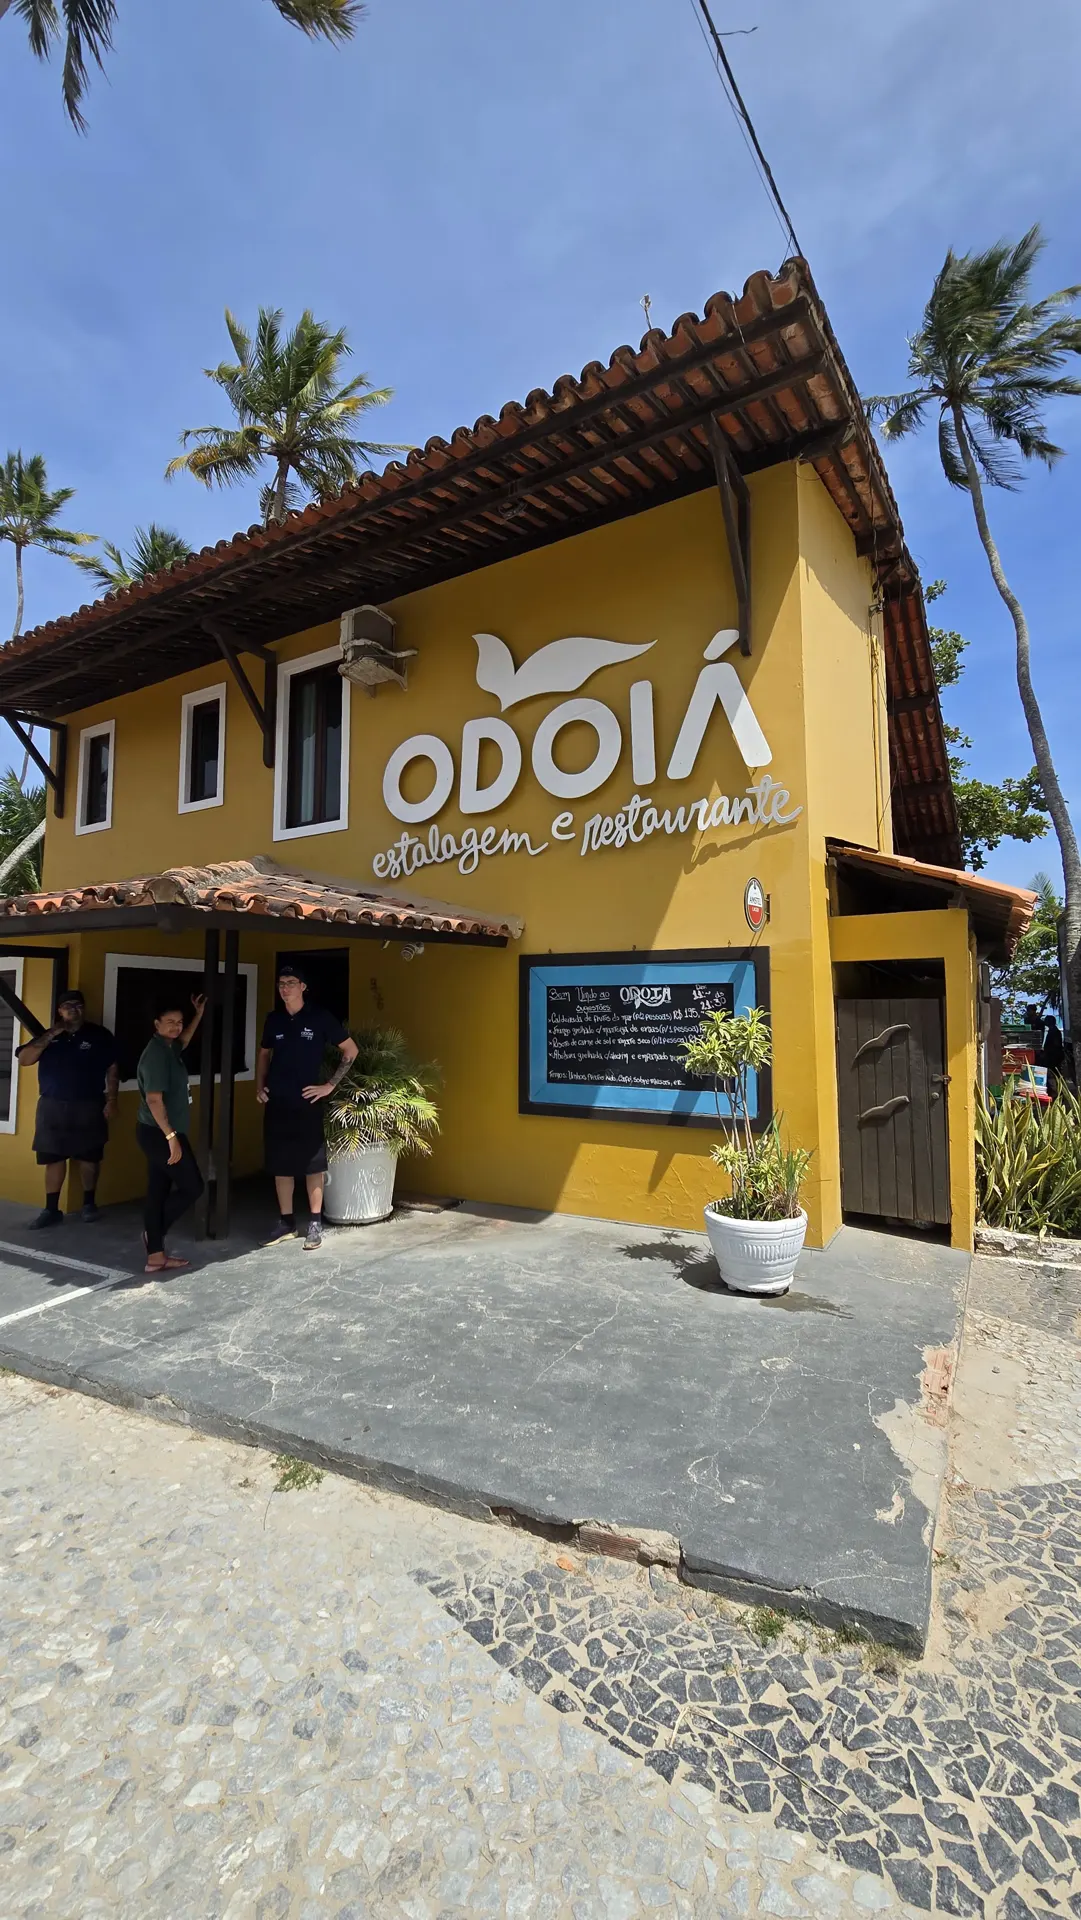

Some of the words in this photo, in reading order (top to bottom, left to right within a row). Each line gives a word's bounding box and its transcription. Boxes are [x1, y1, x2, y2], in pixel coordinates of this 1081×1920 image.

[383, 629, 773, 823] ODOIÁ
[372, 824, 549, 880] estalagem
[551, 811, 576, 841] e
[580, 774, 803, 857] restaurante
